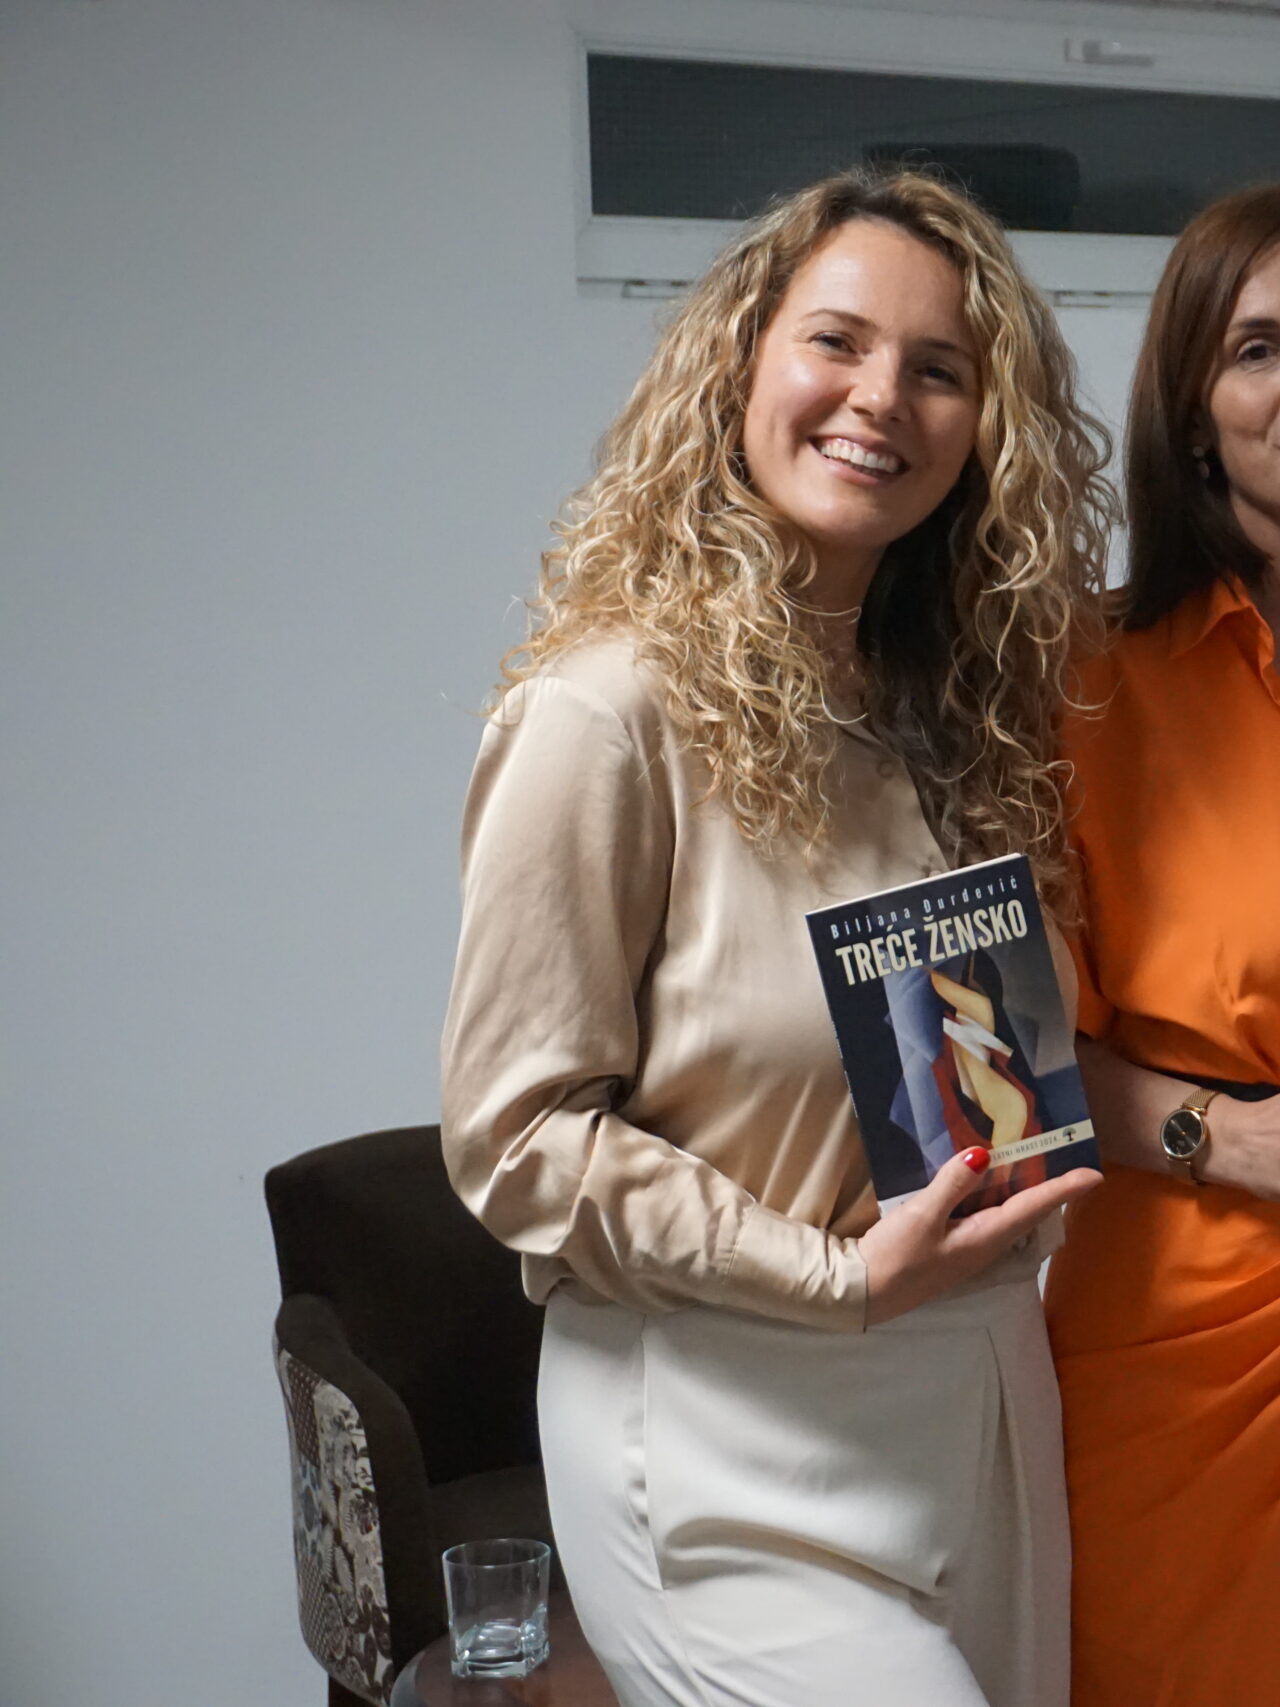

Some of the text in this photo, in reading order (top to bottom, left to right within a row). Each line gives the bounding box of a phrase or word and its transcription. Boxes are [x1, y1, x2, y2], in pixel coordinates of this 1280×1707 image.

[830, 907, 911, 940] Biljana
[835, 899, 1028, 986] TREĆE ŽENSKO
